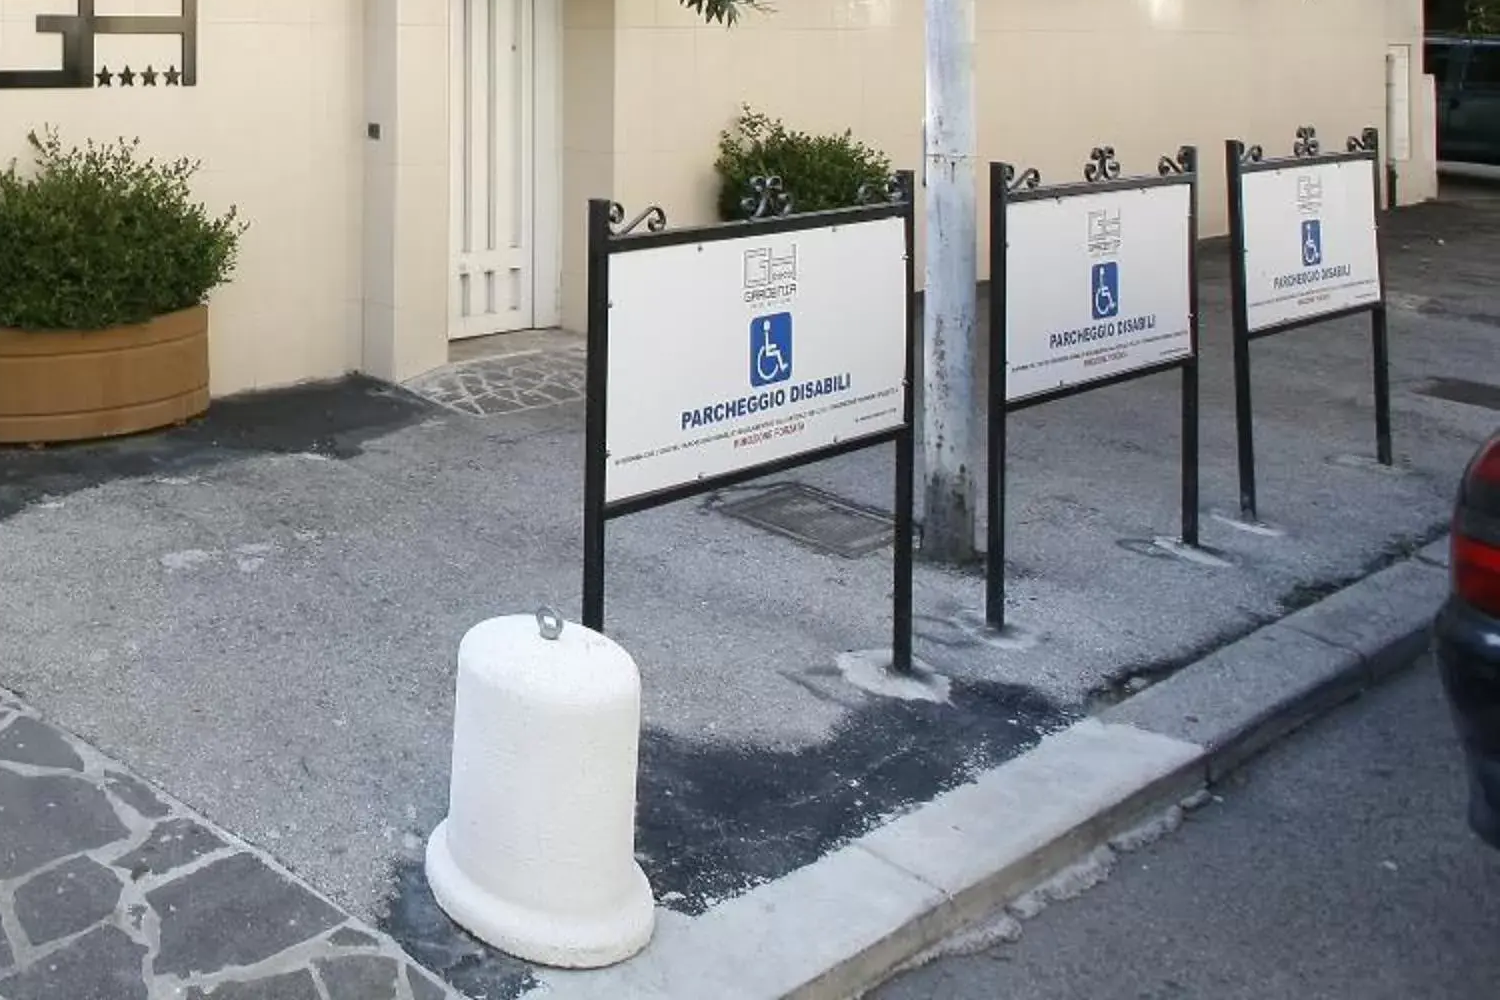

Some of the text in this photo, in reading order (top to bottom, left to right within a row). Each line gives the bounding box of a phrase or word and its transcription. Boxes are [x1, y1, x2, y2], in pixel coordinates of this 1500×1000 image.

[1049, 323, 1115, 349] PARCHEGGIO
[1117, 314, 1156, 335] DISABILI
[681, 389, 786, 430] PARCHEGGIO
[789, 372, 851, 403] DISABILI
